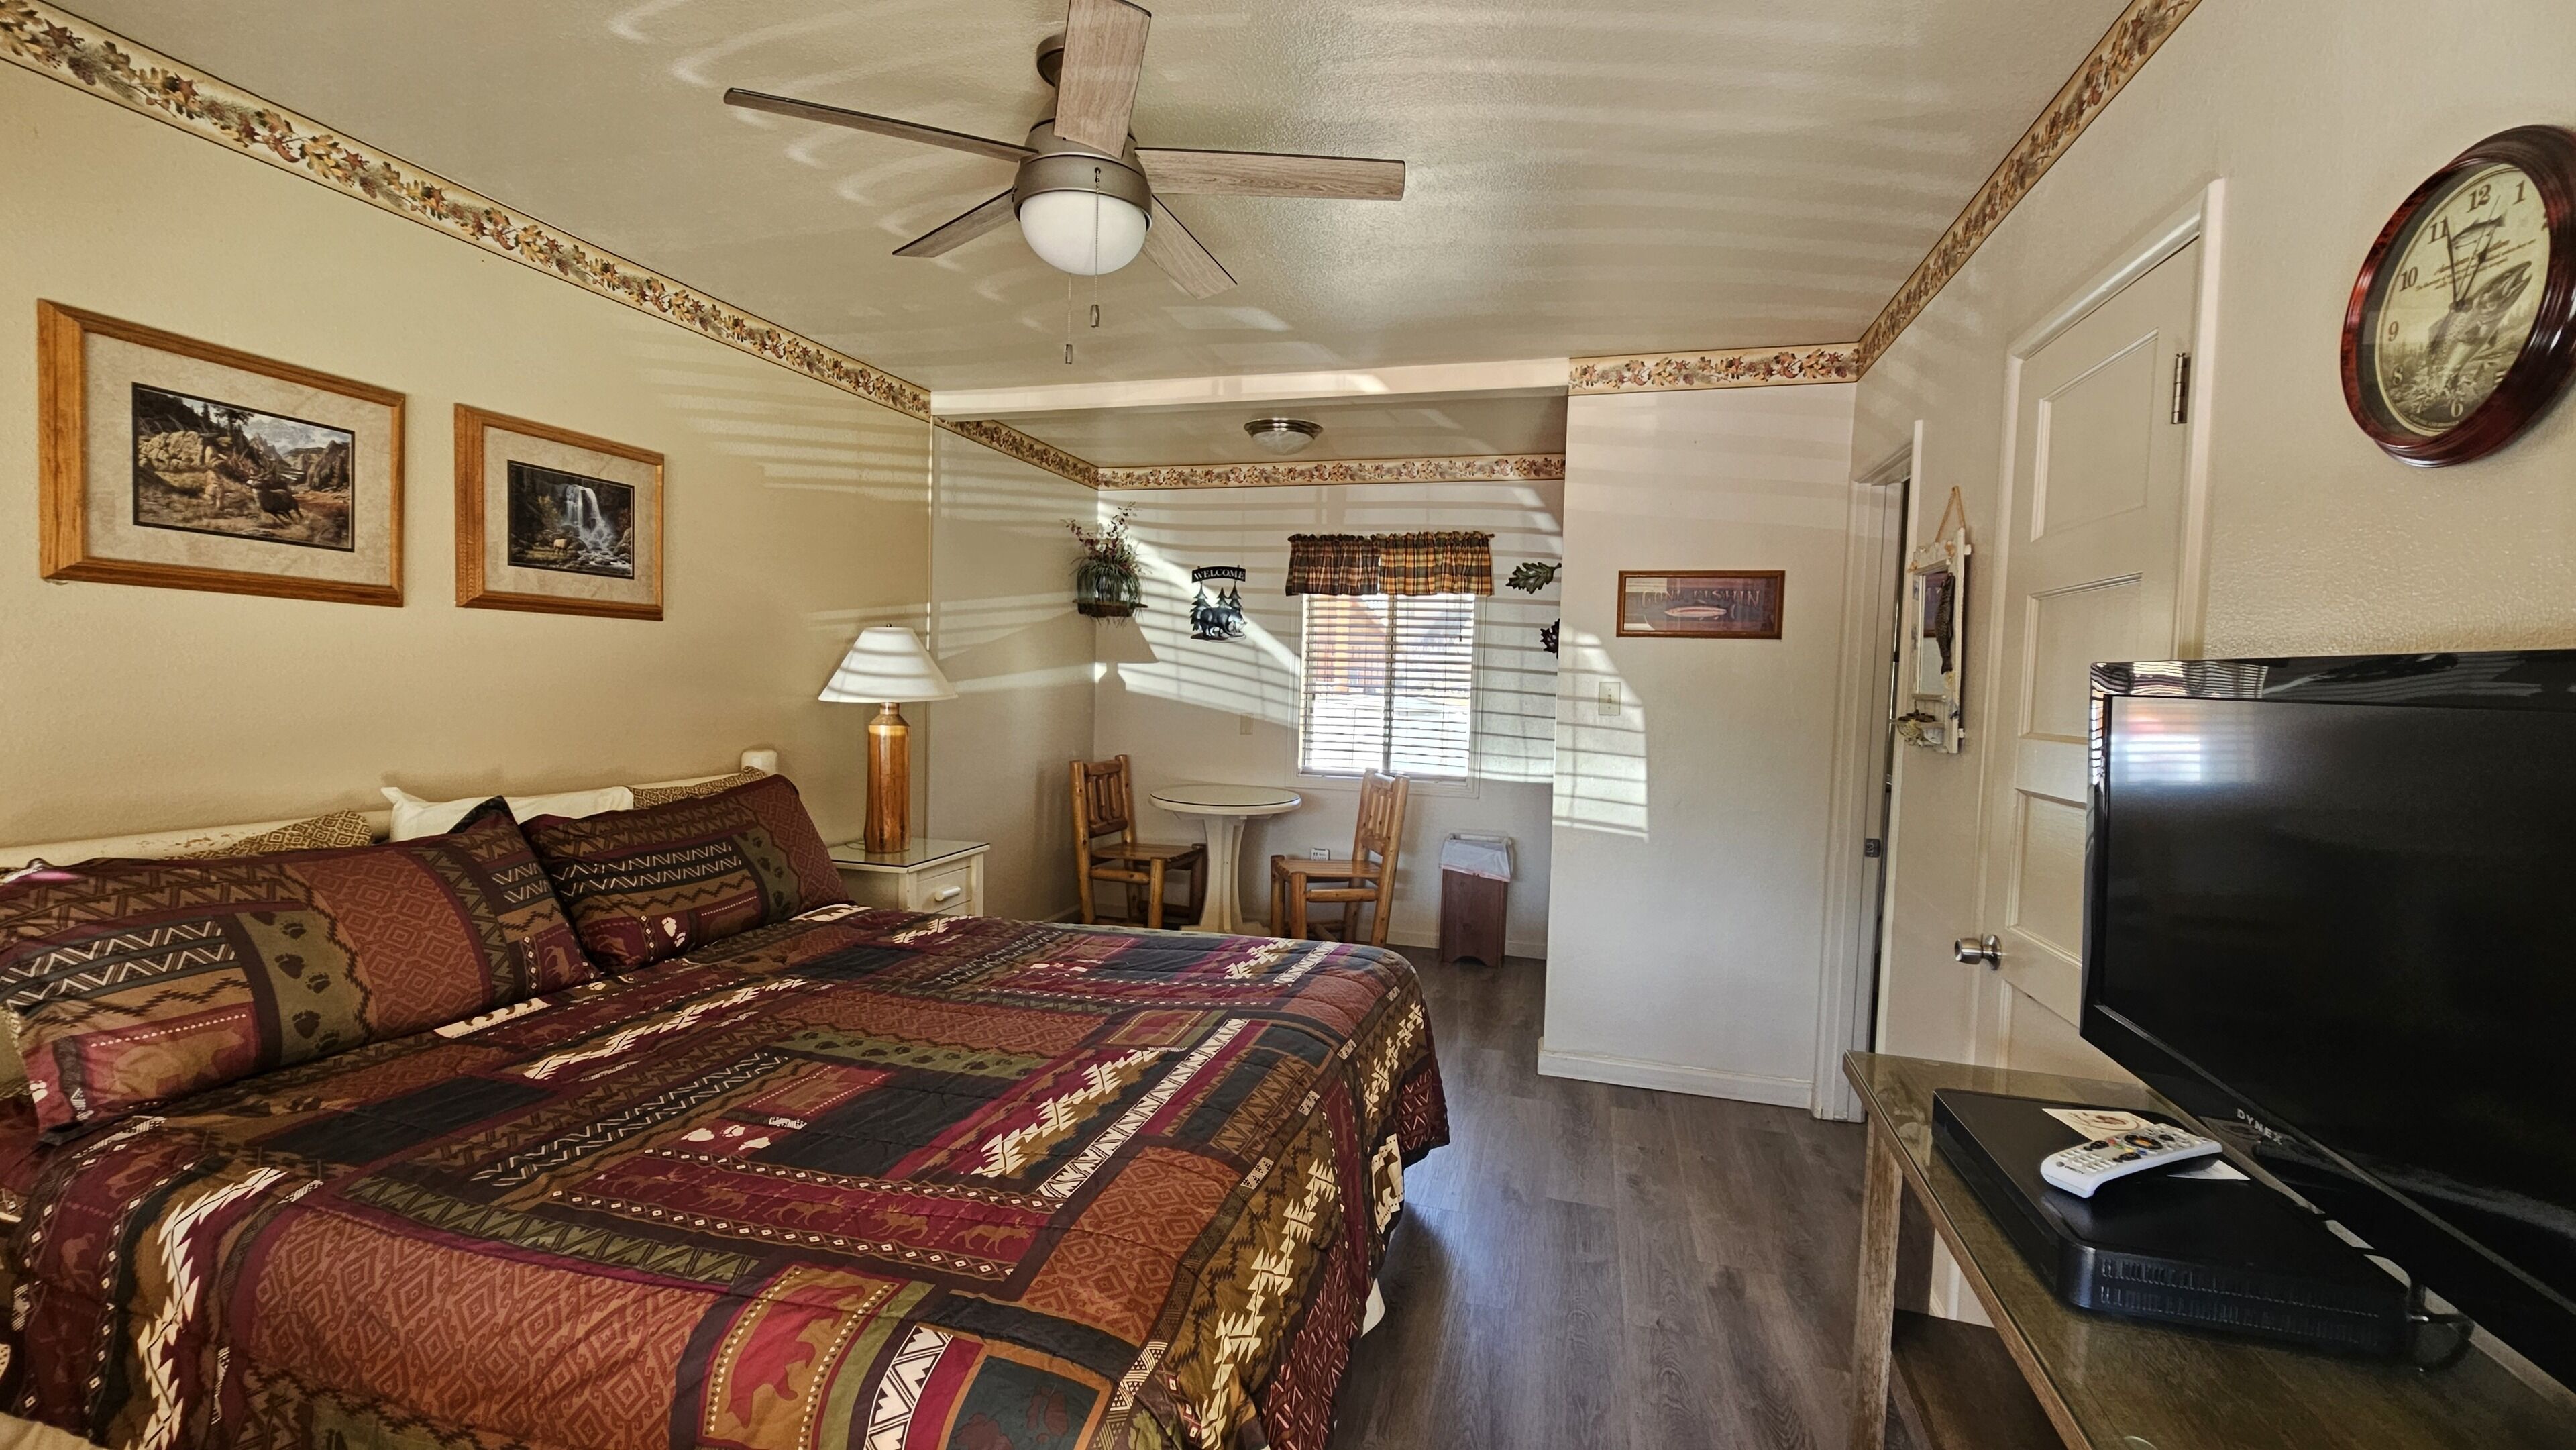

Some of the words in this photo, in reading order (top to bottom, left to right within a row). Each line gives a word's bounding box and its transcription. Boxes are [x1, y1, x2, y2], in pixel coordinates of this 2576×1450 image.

[2467, 184, 2491, 213] 12
[2512, 180, 2526, 205] 1
[2428, 216, 2449, 244] 11
[2398, 266, 2419, 293] 10
[2388, 321, 2400, 342] 9
[2392, 364, 2404, 386] 8
[2451, 397, 2464, 418] 6
[1194, 569, 1244, 579] WELCOME
[1693, 590, 1759, 607] FISHIN
[2237, 1108, 2282, 1145] DYNEX
